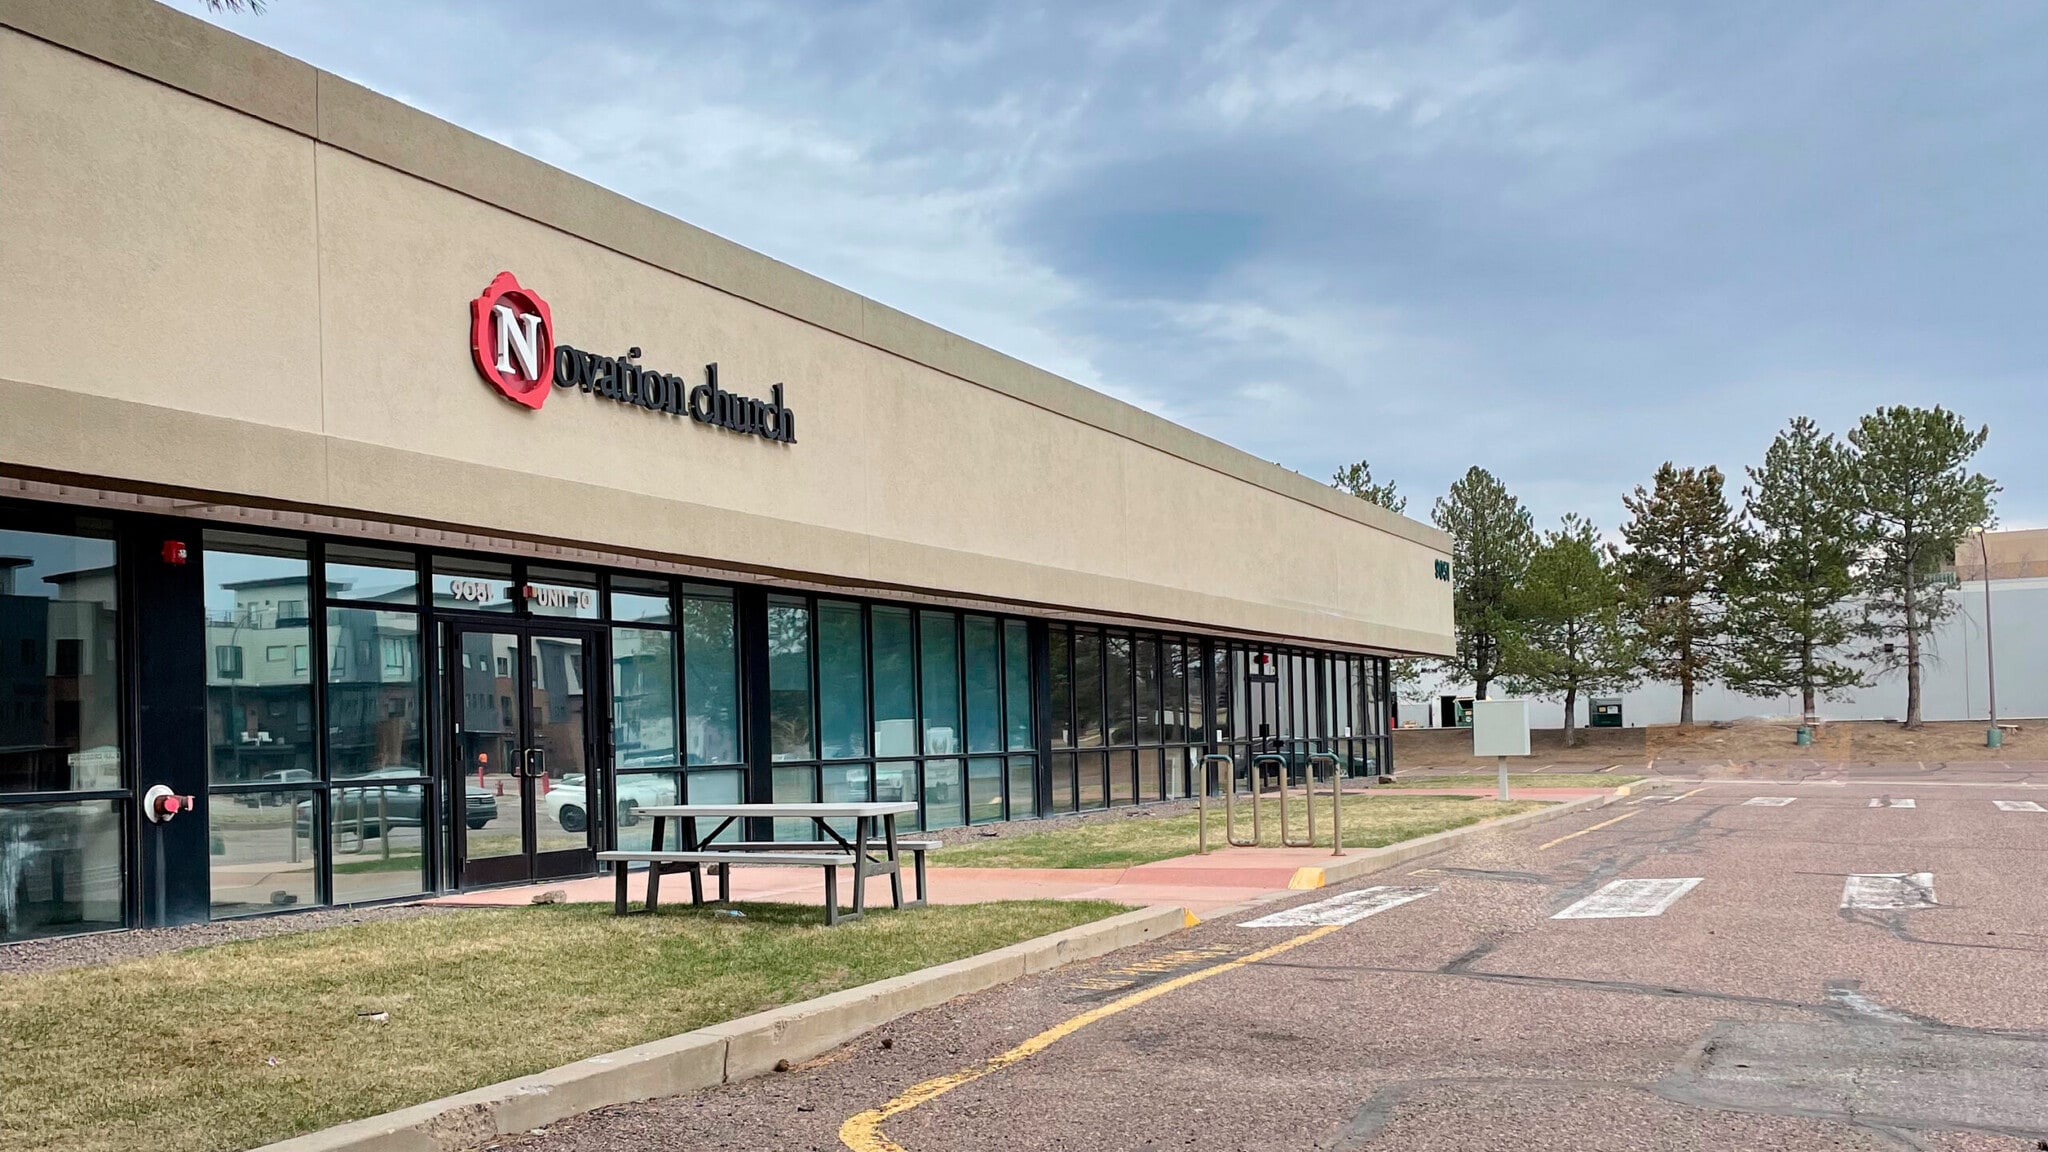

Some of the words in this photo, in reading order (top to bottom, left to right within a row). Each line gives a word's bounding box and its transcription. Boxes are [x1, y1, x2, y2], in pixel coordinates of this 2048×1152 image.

[492, 305, 689, 417] Novation
[689, 362, 797, 444] church
[537, 588, 569, 608] UNIT
[574, 591, 591, 608] 10
